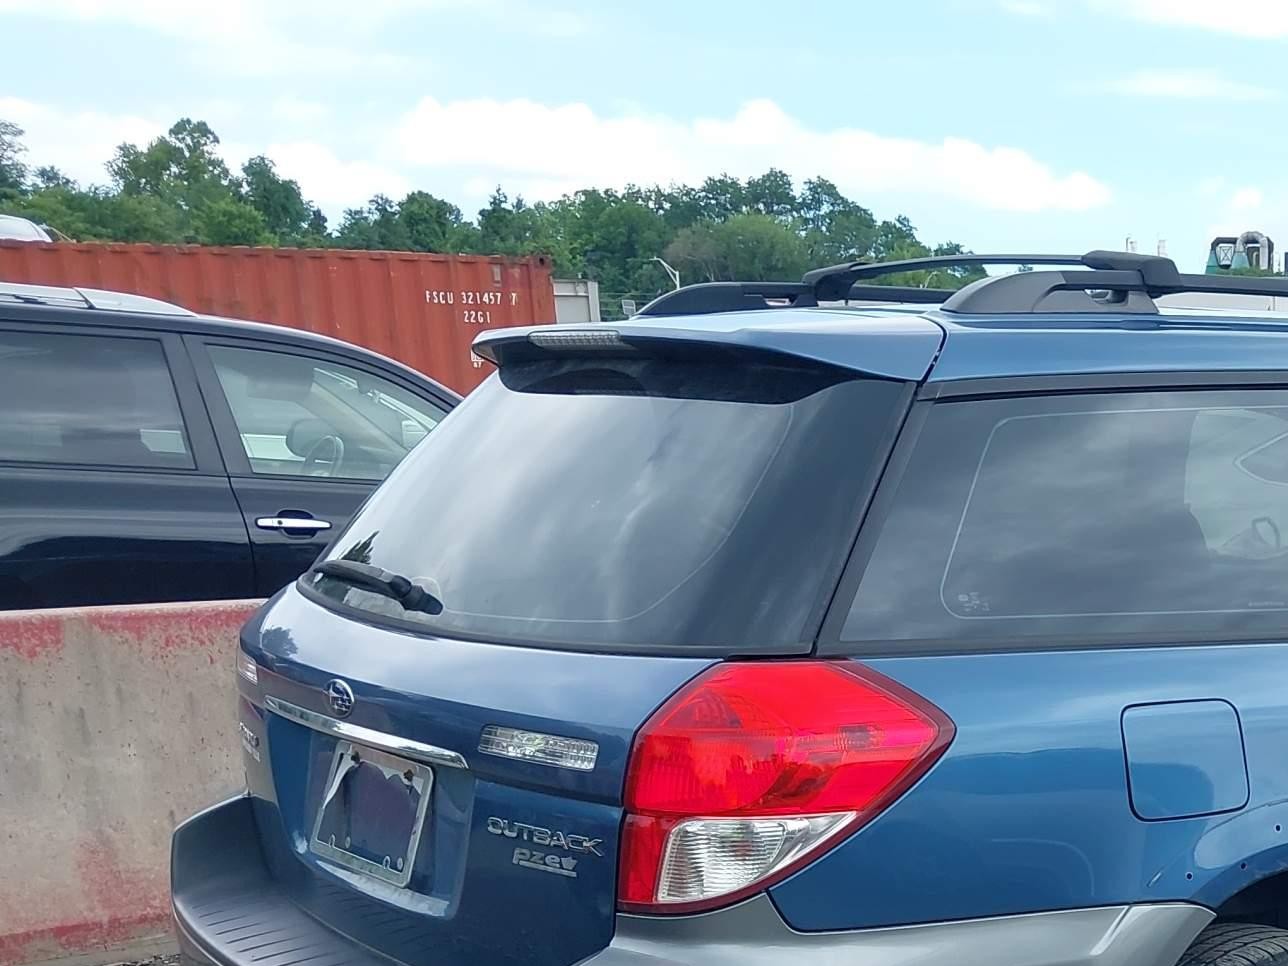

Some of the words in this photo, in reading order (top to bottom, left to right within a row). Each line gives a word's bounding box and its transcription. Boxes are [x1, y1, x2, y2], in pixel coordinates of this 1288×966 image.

[425, 290, 454, 304] FSCU
[461, 292, 502, 304] 321457
[463, 310, 491, 323] 22G1
[487, 816, 604, 857] OUTBACK
